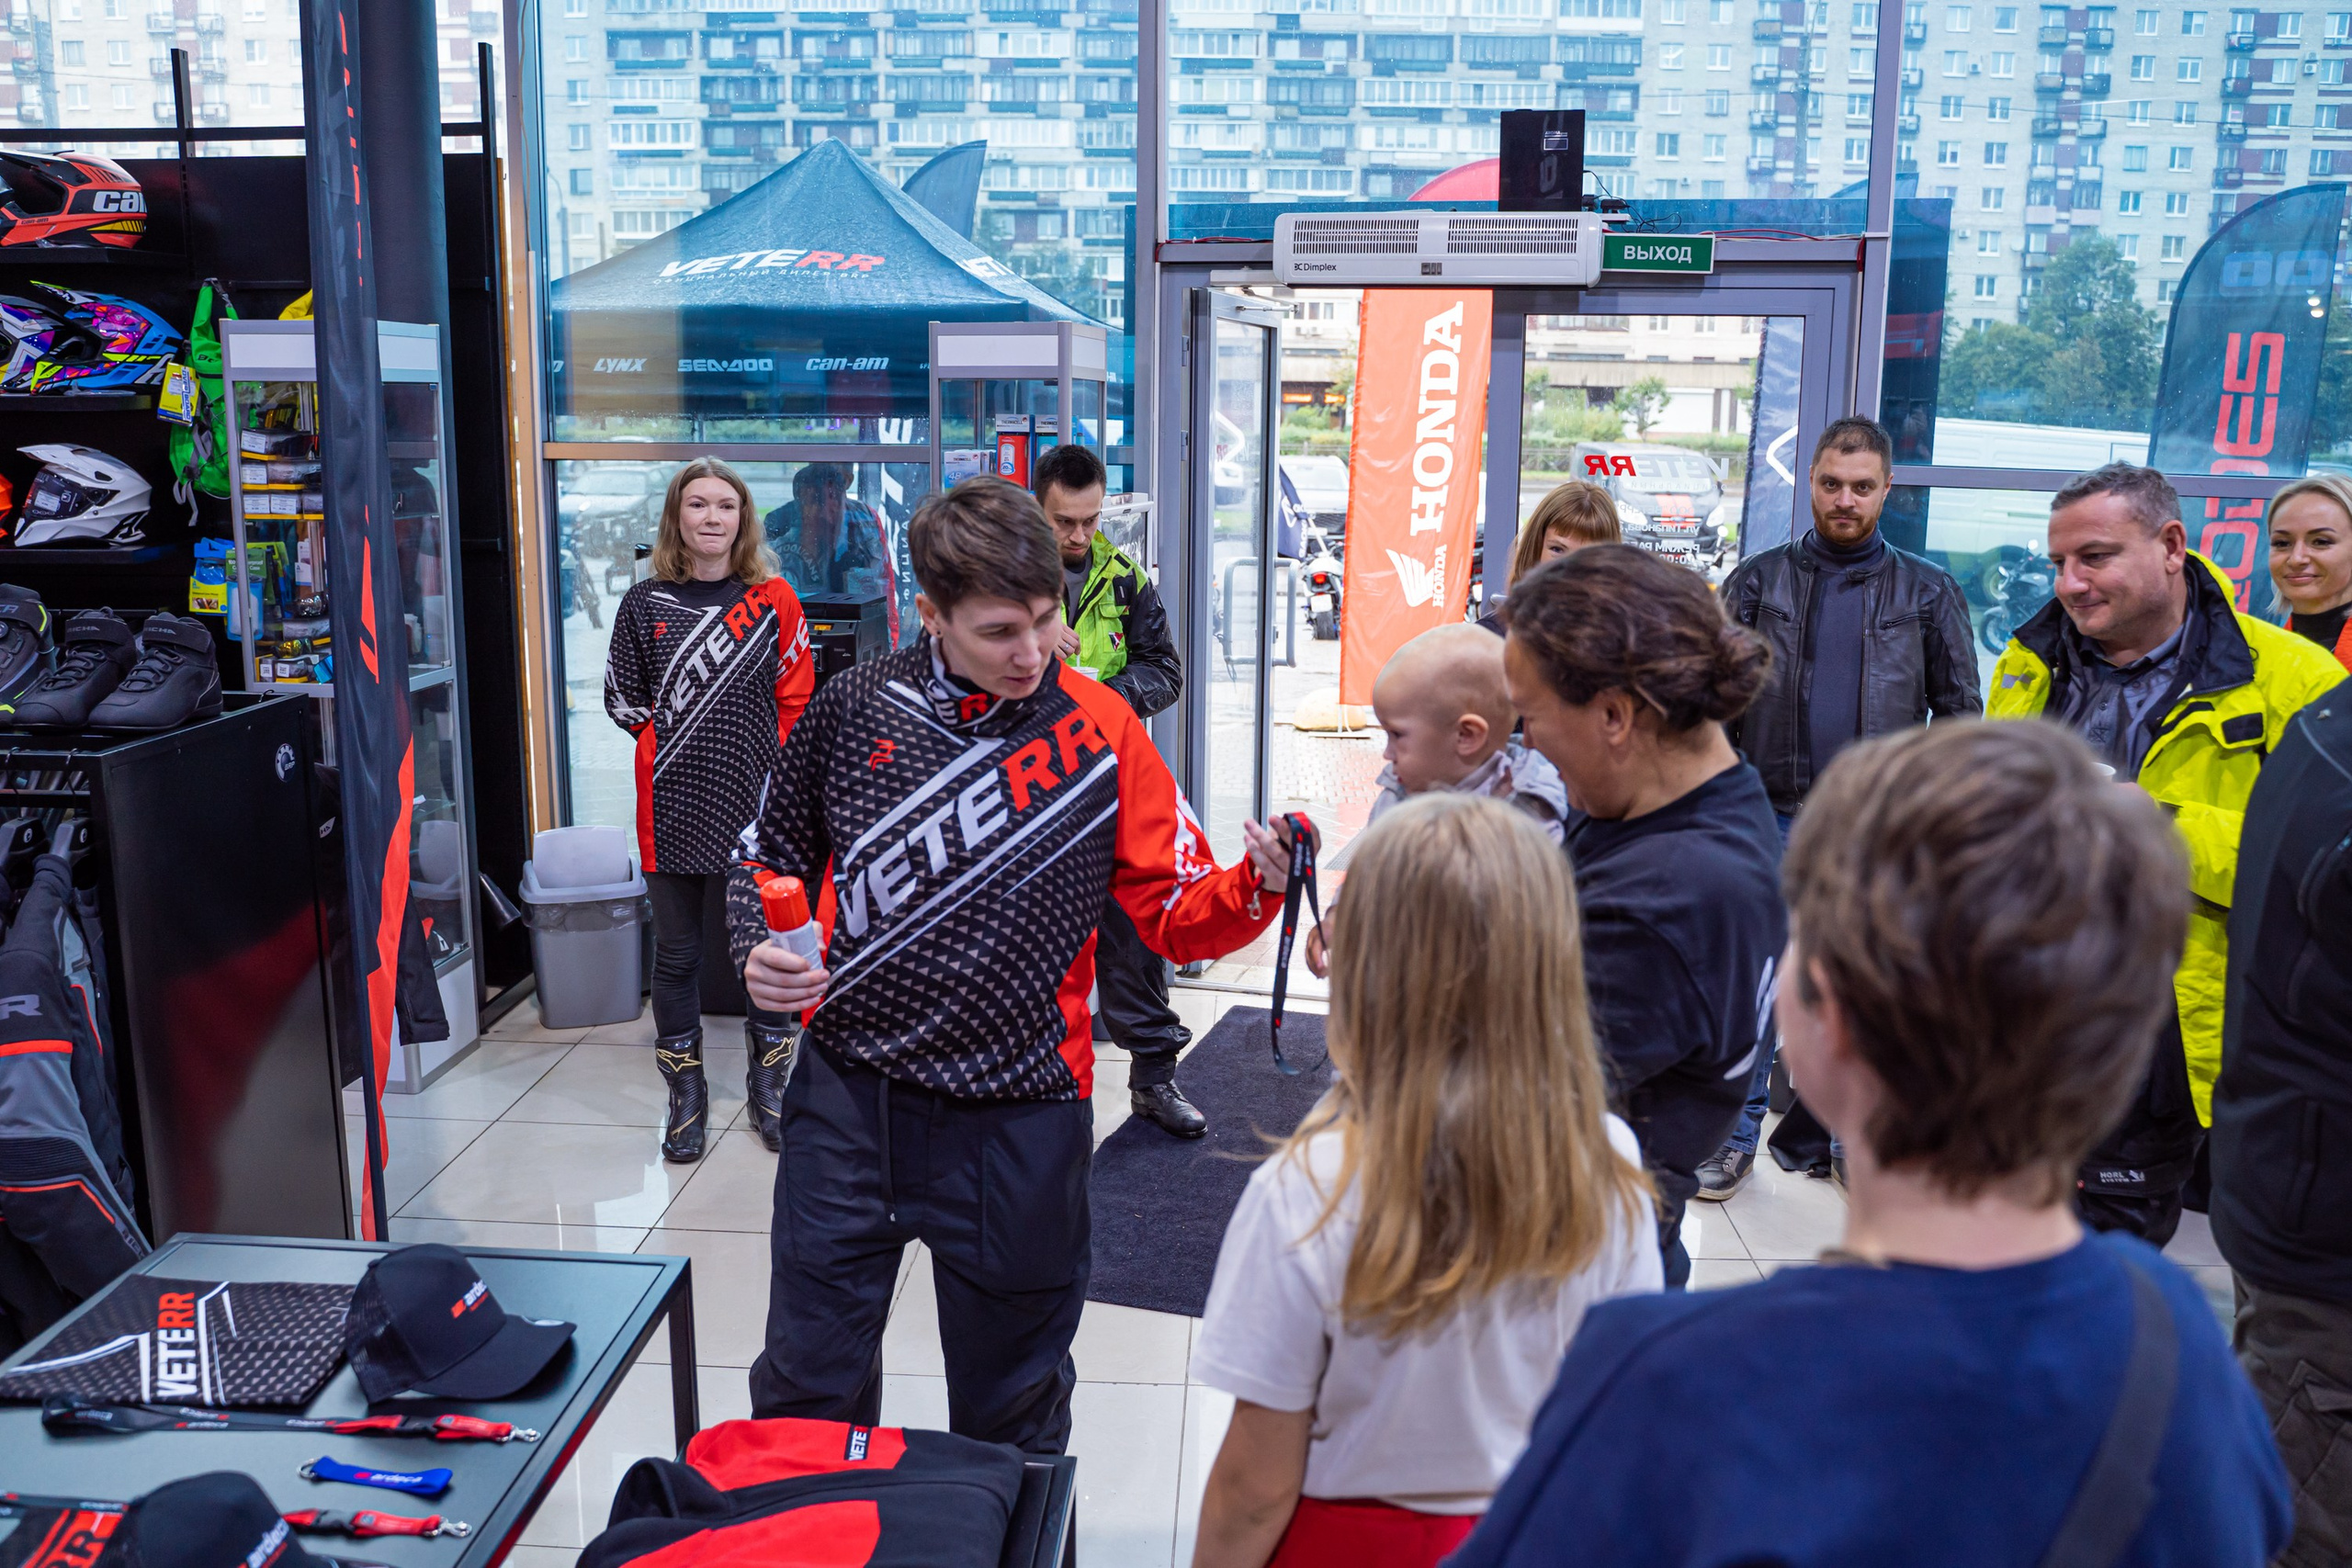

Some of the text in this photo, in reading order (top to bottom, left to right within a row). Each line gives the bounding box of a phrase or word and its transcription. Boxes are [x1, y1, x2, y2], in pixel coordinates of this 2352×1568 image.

[659, 249, 886, 277] VETERR
[1623, 245, 1692, 264] ВЫХОД
[653, 268, 770, 285] ОФИЦИАЛЬНЫЙ
[1304, 263, 1337, 272] Dimplex
[593, 357, 649, 373] LYNX
[805, 356, 889, 371] can-am
[1409, 300, 1464, 536] HONDA
[948, 471, 962, 480] 48
[1432, 544, 1448, 608] HONDA
[838, 707, 1108, 939] VETERR
[156, 1292, 198, 1397] VETERR
